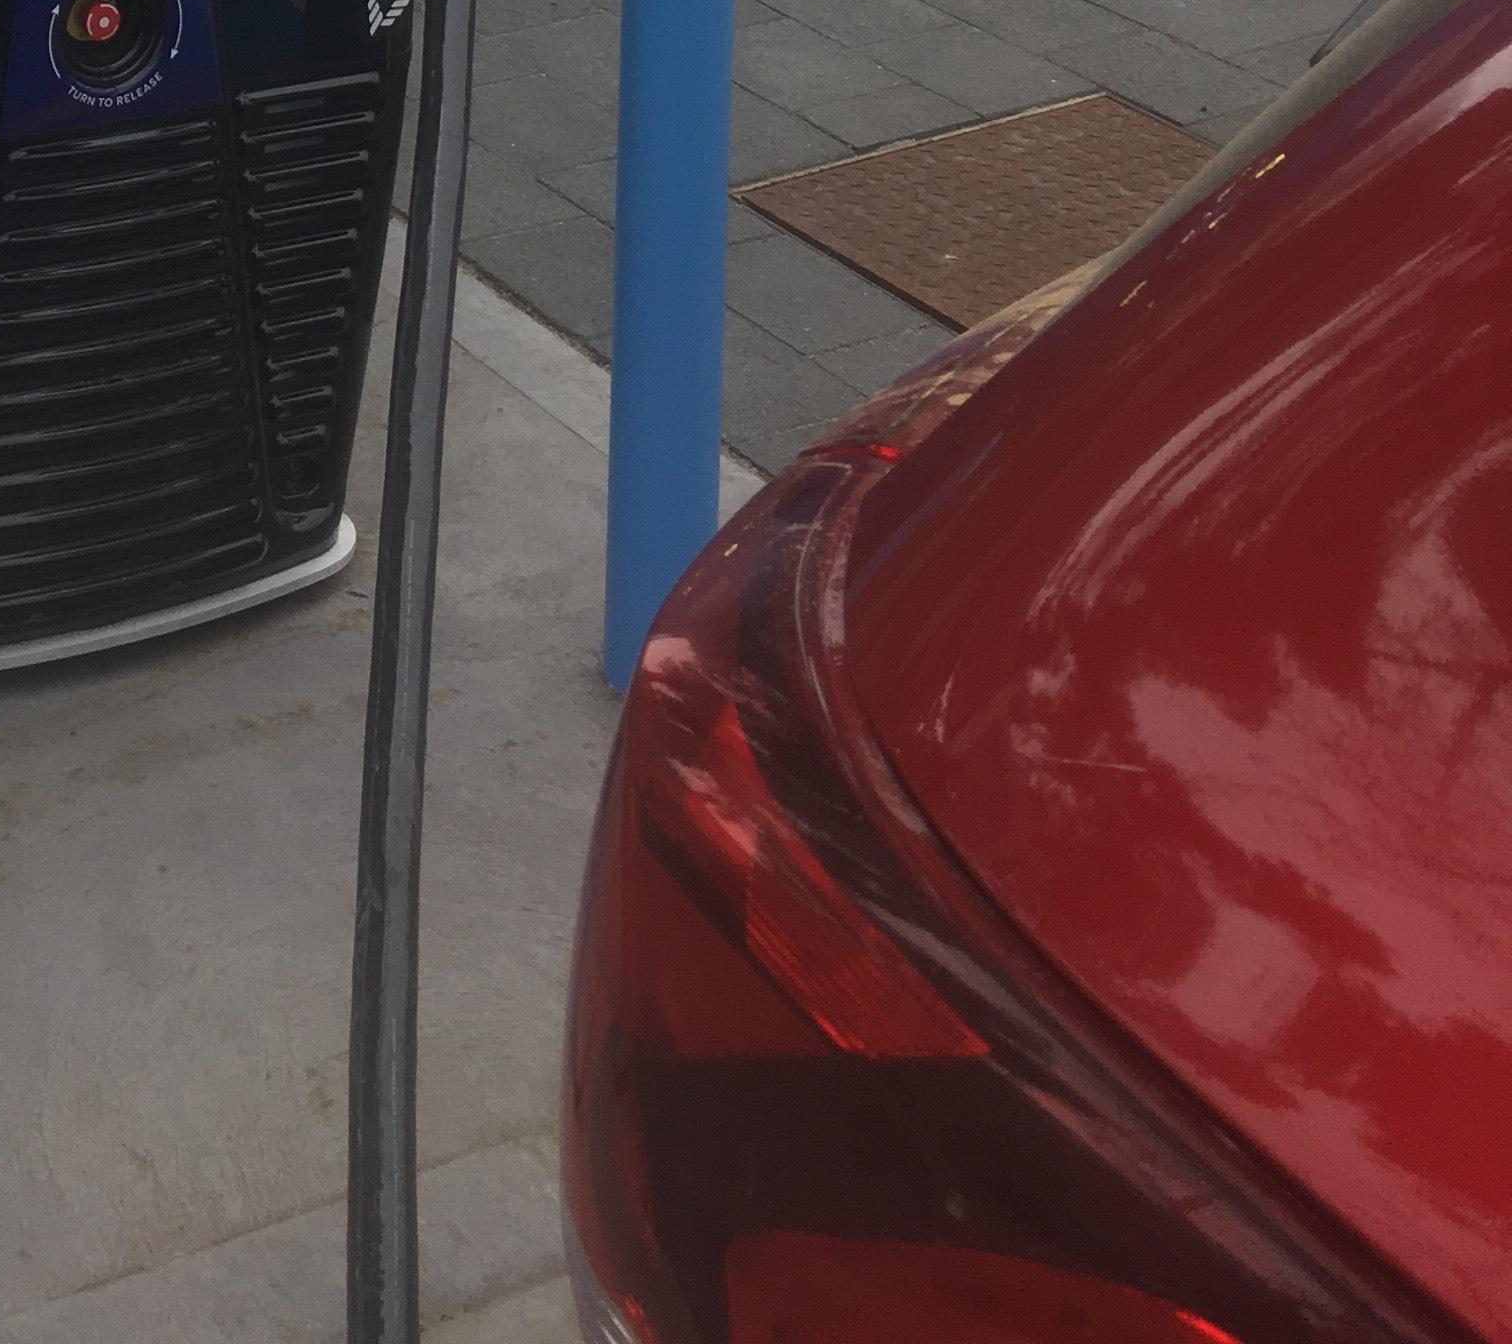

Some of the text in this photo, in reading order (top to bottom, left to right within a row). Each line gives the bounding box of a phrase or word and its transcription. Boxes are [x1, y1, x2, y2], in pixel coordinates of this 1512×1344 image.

[67, 71, 164, 108] TURN TO RELEASE
